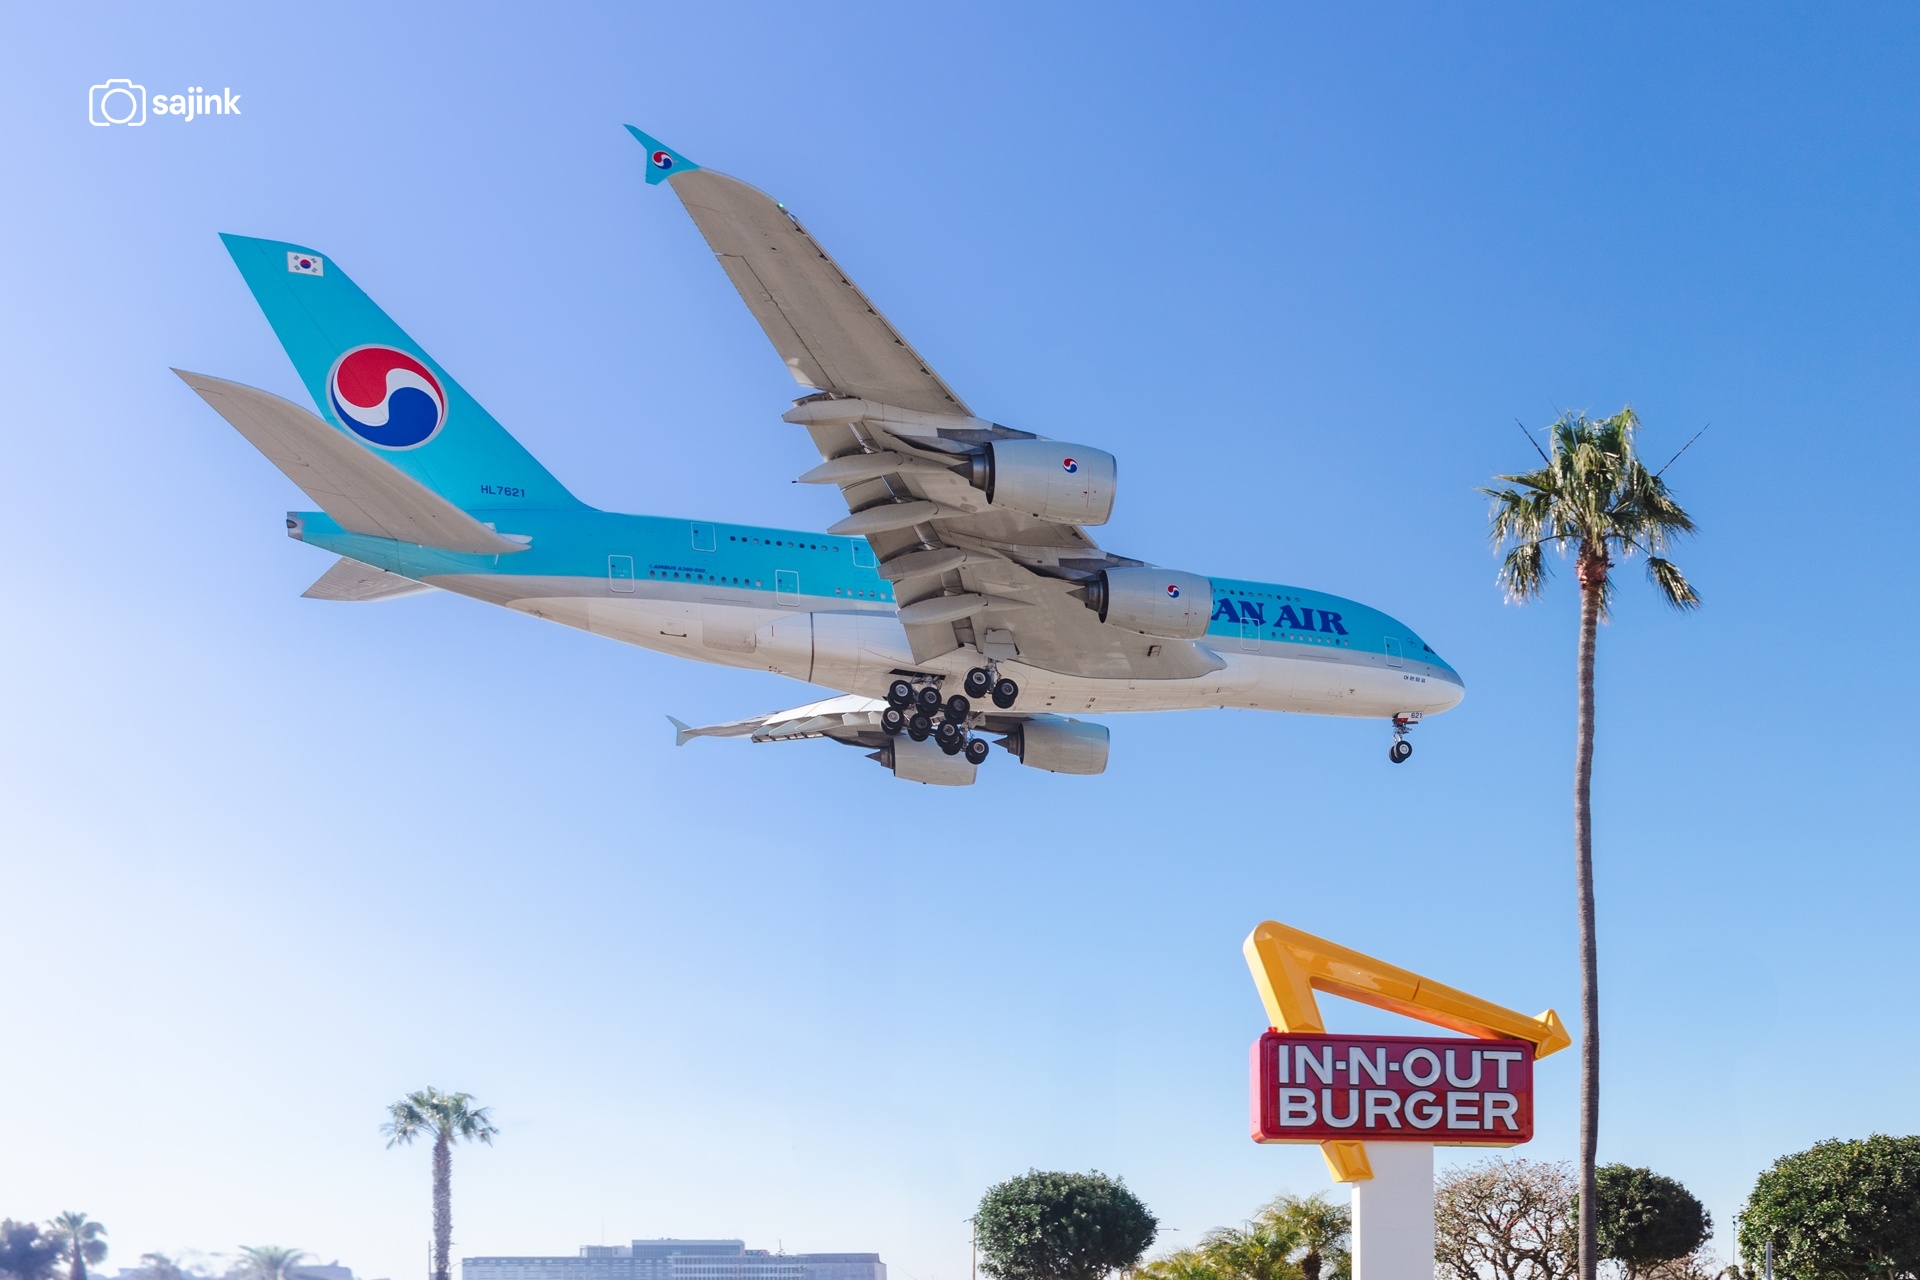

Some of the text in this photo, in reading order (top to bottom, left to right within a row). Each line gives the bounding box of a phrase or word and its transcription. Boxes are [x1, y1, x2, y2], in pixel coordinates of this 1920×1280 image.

[480, 484, 525, 498] HL7621
[1211, 597, 1349, 636] AN AIR
[1277, 1044, 1523, 1090] IN-N-OUT
[1278, 1087, 1520, 1131] BURGER
